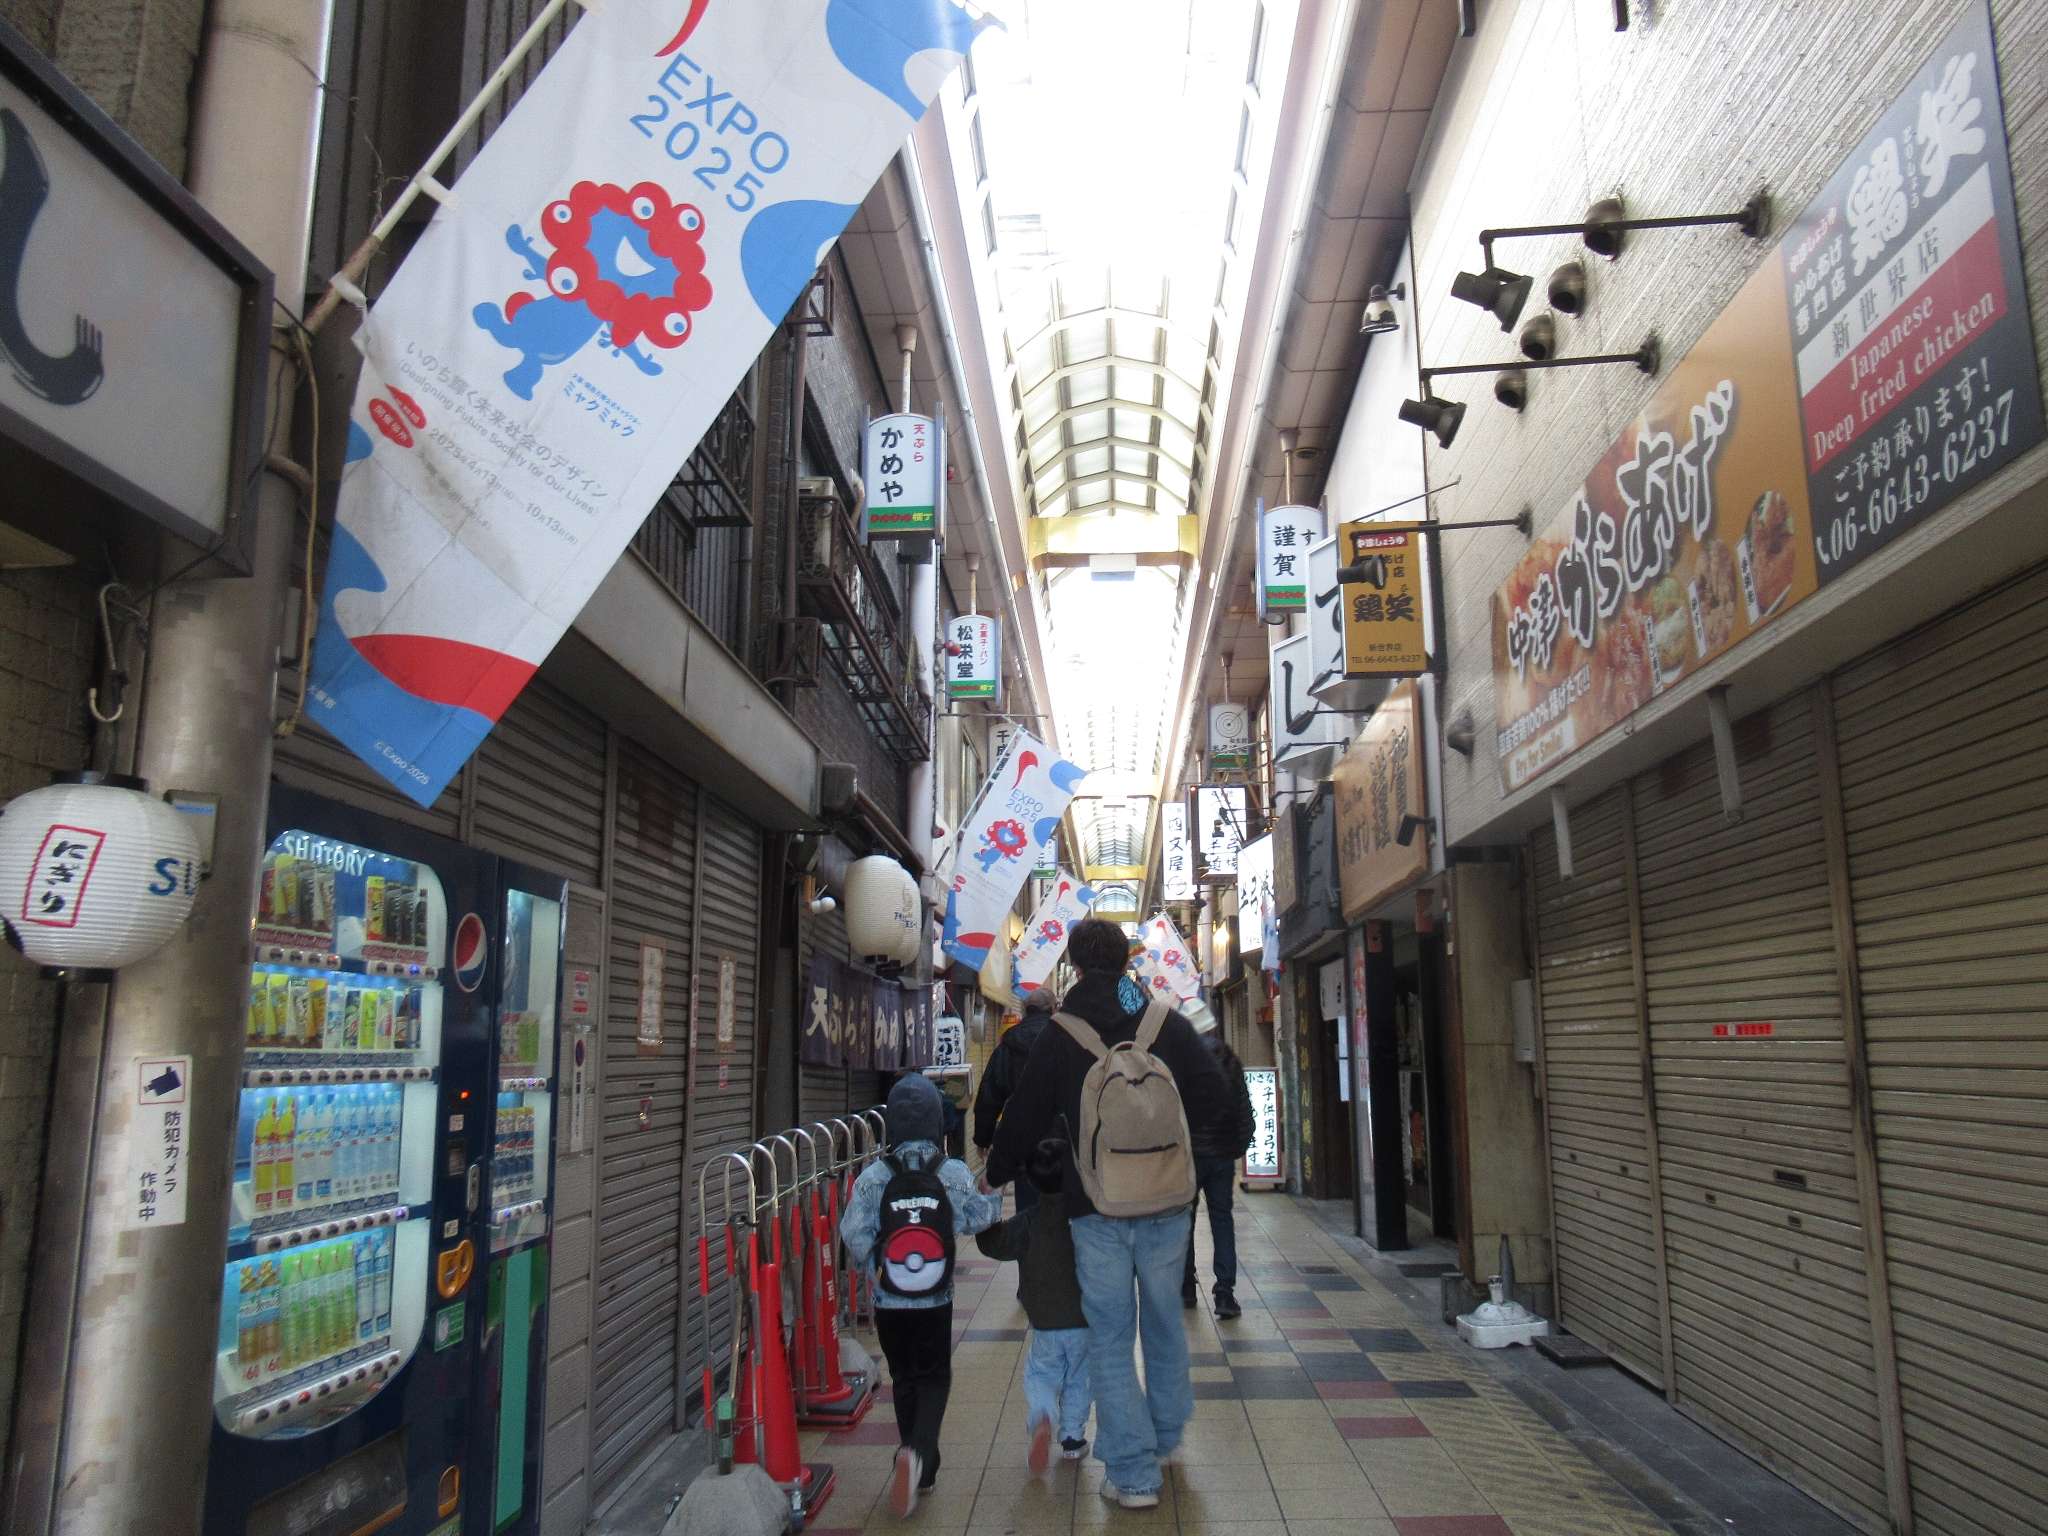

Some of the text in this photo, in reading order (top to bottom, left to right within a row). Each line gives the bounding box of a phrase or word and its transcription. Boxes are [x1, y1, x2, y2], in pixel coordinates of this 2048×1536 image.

[657, 53, 789, 173] EXPO
[629, 95, 765, 212] 2025
[1832, 226, 1939, 358] 新世界店
[1813, 292, 1995, 461] Deep fried chicken
[1850, 295, 1933, 391] Japanese
[454, 403, 490, 438] Future
[527, 460, 544, 477] for
[544, 471, 565, 494] Our
[880, 427, 904, 503] かめや
[913, 423, 925, 463] 天ぷら
[1829, 388, 2014, 561] 06-6643-6237
[1273, 524, 1297, 577] 謹賀
[957, 625, 974, 678] 松栄堂
[1006, 799, 1038, 823] 2025
[1011, 788, 1044, 813] EXPO
[41, 840, 89, 914] にぎり
[164, 1110, 182, 1194] 防犯カメラ
[138, 1170, 158, 1222] 作動中
